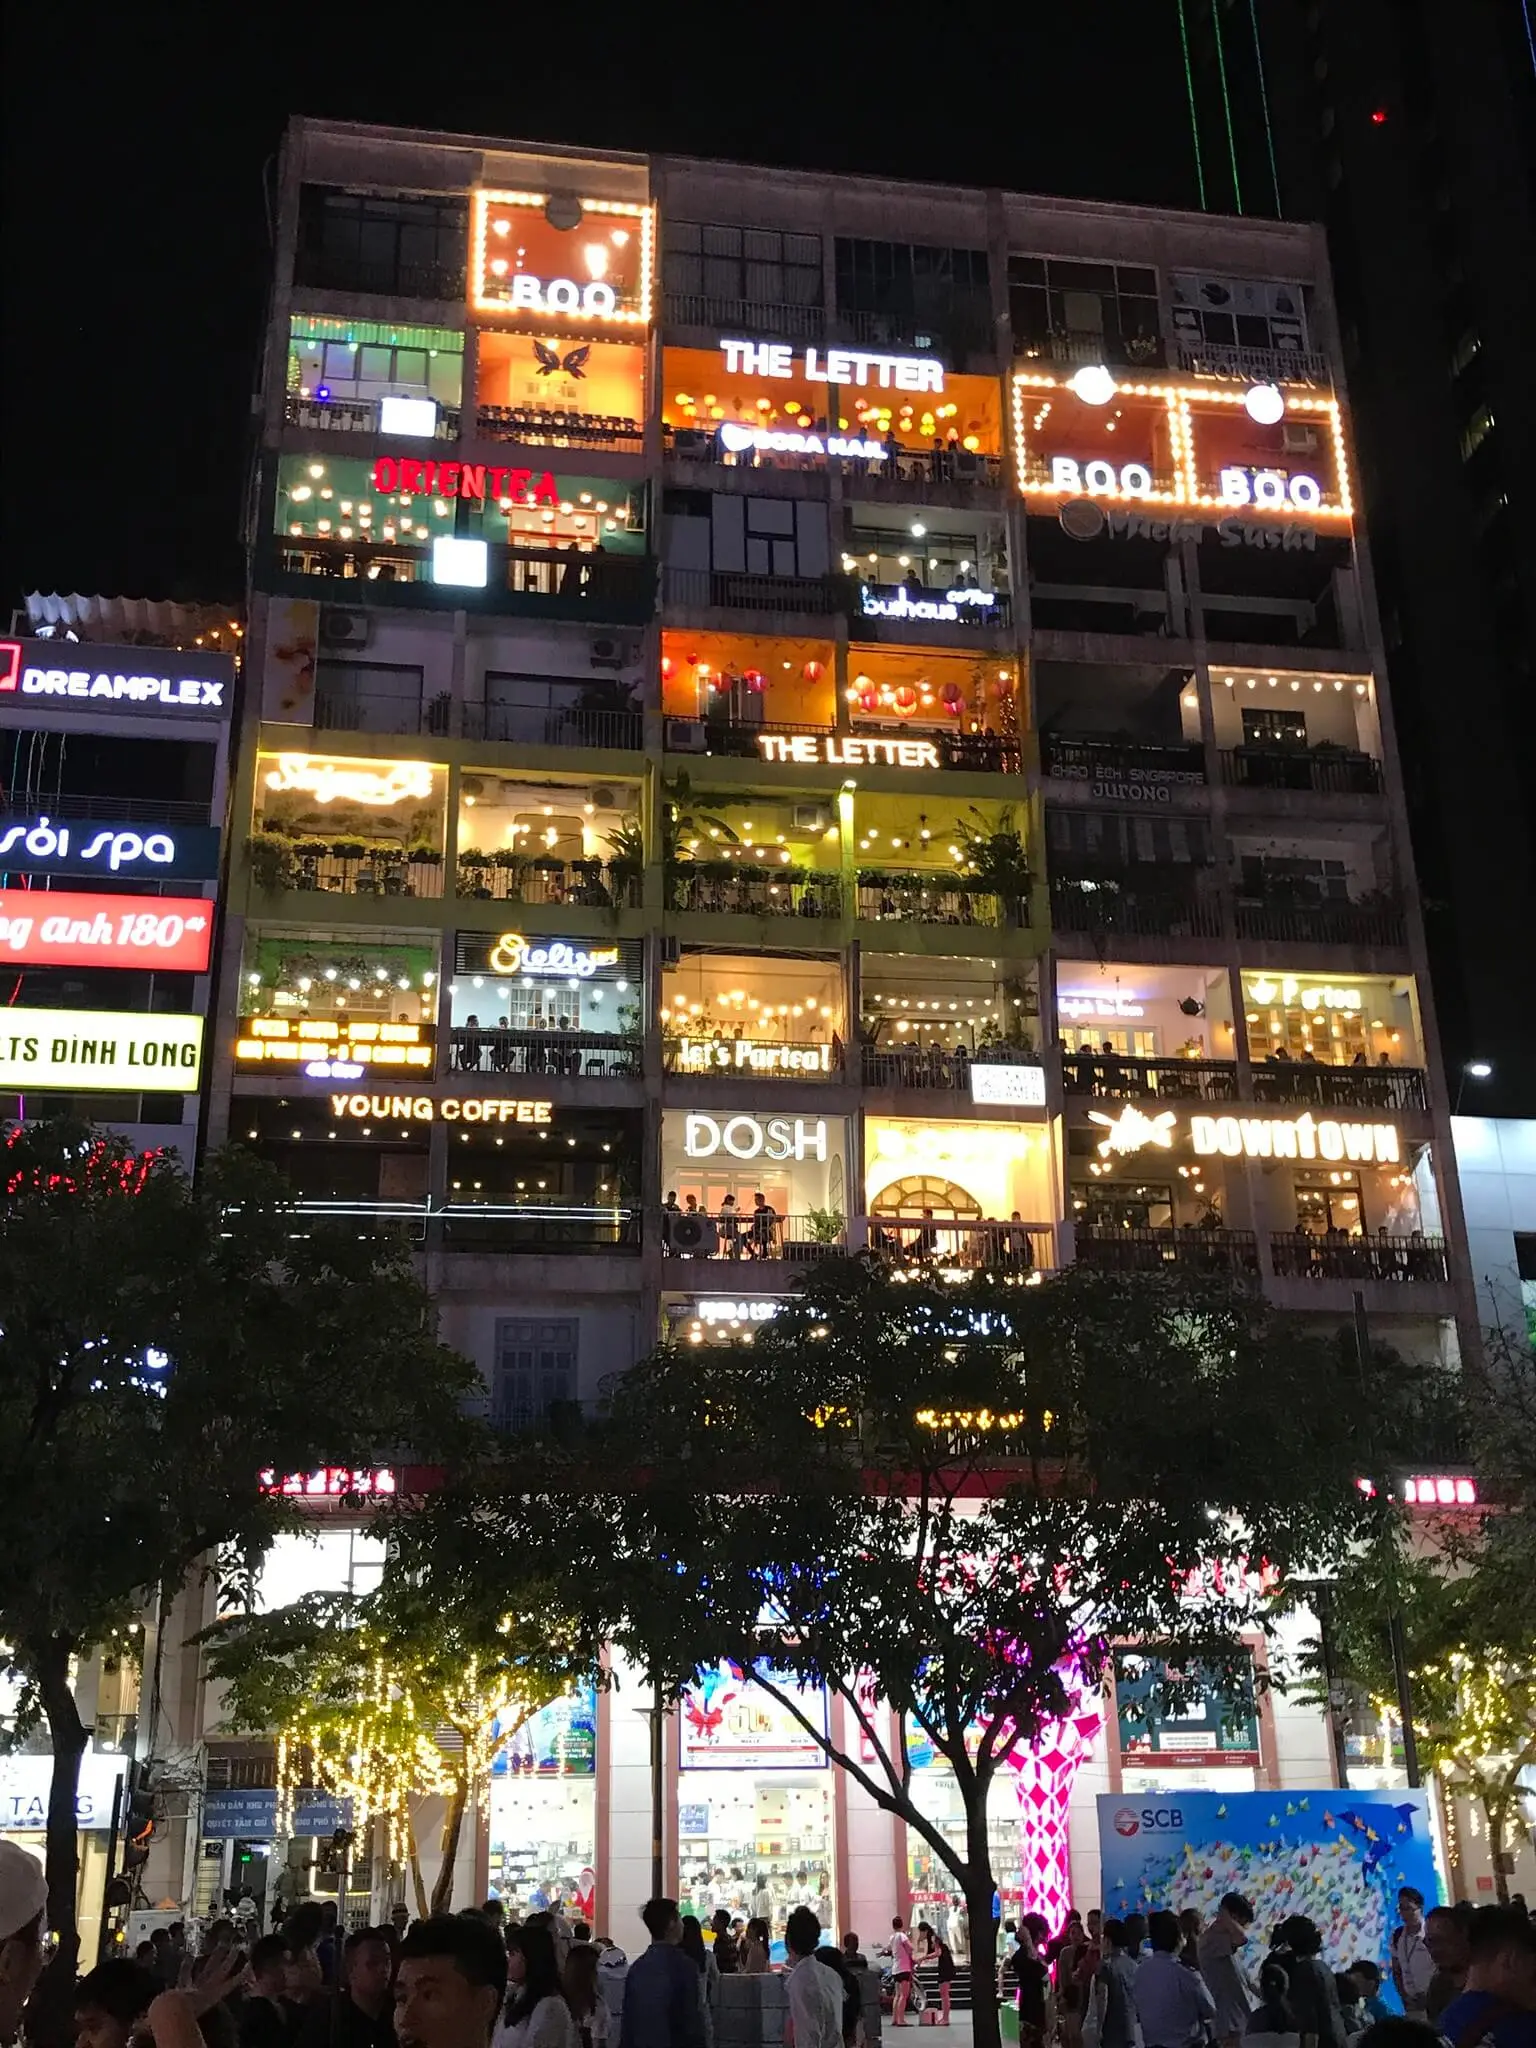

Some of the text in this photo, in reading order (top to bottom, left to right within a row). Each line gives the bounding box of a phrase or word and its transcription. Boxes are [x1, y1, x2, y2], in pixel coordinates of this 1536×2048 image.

[512, 275, 615, 316] BOO
[719, 339, 944, 393] THE LETTER
[371, 456, 560, 506] ORIENTEA
[1052, 457, 1151, 498] BOO
[1220, 469, 1320, 509] BOO
[22, 668, 224, 706] DREAMPLEX
[758, 735, 940, 768] THE LETTER
[81, 830, 175, 871] spa
[40, 912, 112, 945] anh
[0, 1037, 39, 1062] TS
[128, 1041, 196, 1068] LONG
[332, 1095, 552, 1123] YOUNG COFFEE
[684, 1114, 827, 1162] DOSH
[1141, 1808, 1184, 1828] SCB
